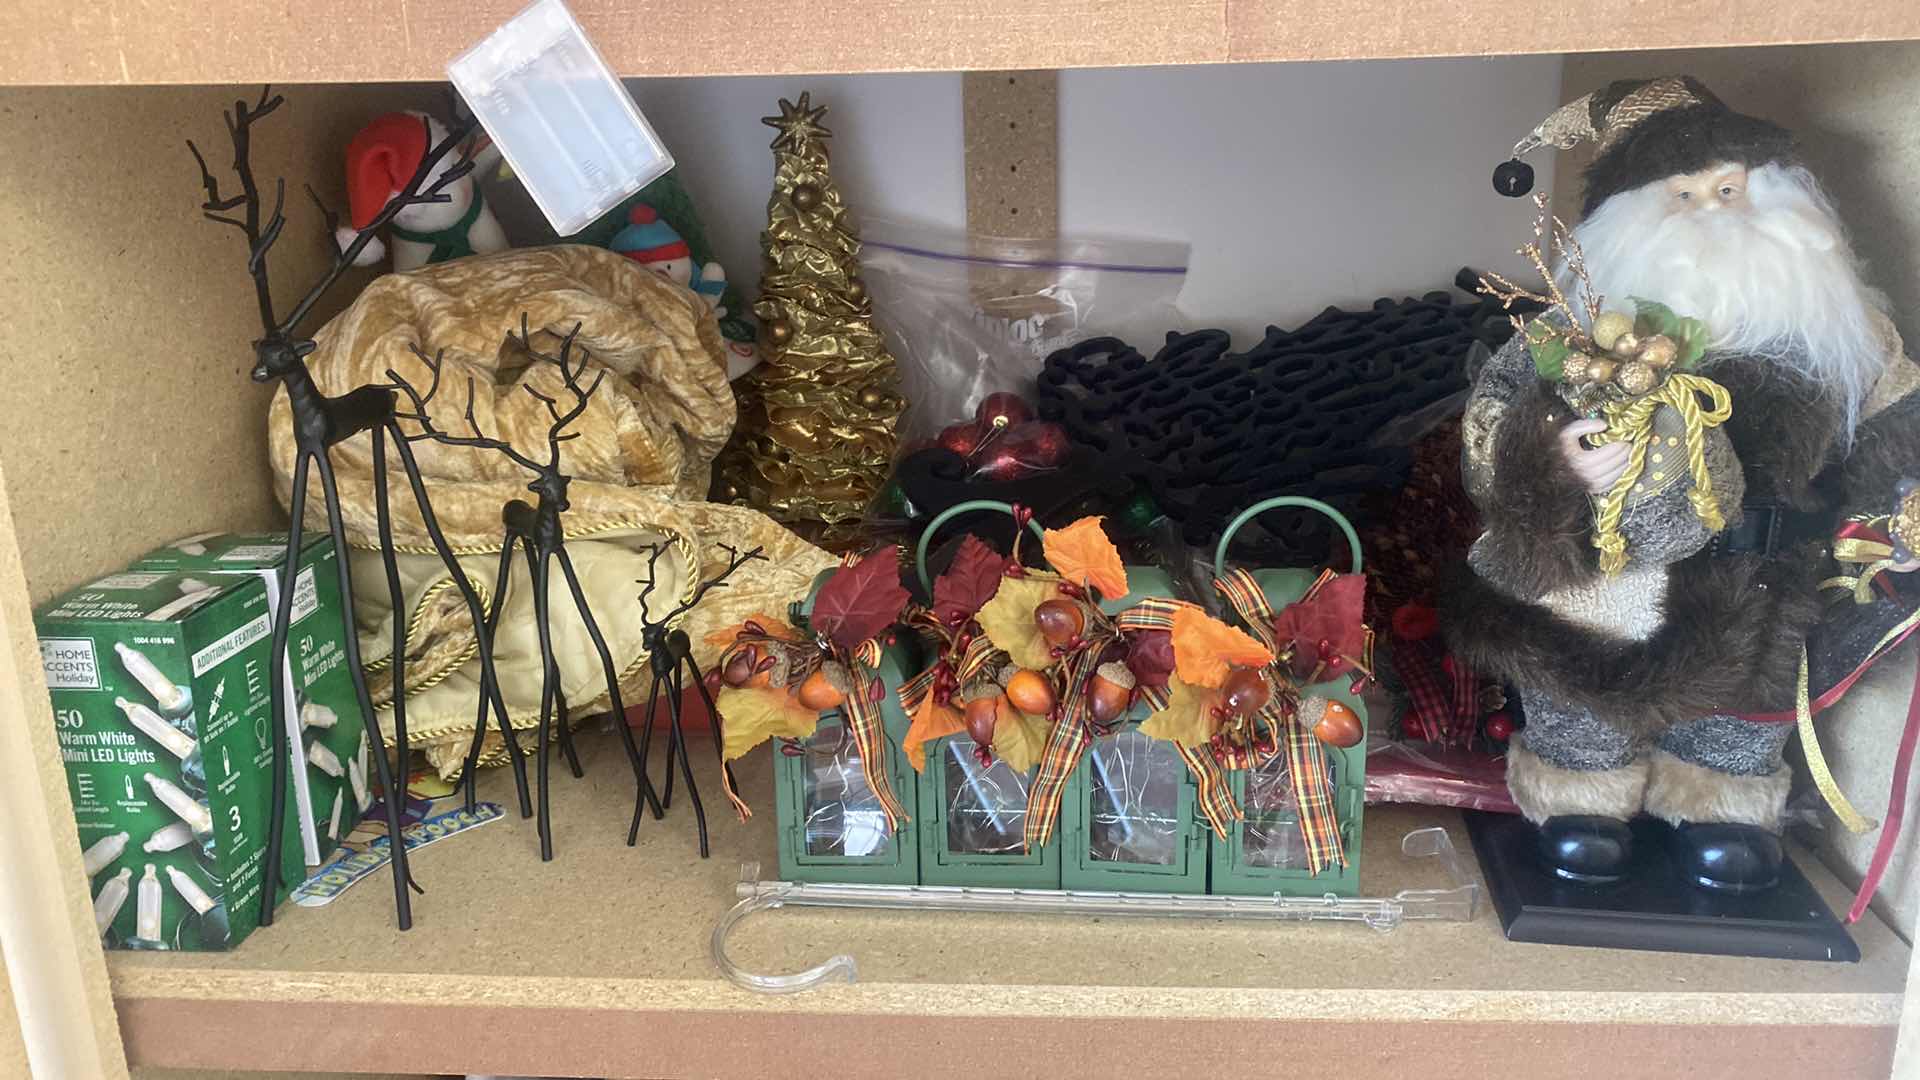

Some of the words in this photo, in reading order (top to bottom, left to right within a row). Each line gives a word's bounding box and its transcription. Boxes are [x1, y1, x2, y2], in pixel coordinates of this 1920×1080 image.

[55, 649, 92, 660] HOME
[197, 639, 235, 670] ADDITIONAL
[234, 620, 266, 647] FEATURES
[300, 635, 314, 656] 50
[56, 673, 95, 684] Holiday
[57, 709, 84, 729] 50
[59, 731, 97, 746] Warm
[98, 731, 136, 746] White
[63, 748, 90, 763] Mini
[92, 748, 115, 763] LED
[117, 748, 156, 765] Lights
[229, 805, 242, 832] 3
[303, 846, 392, 897] HOLIDA
